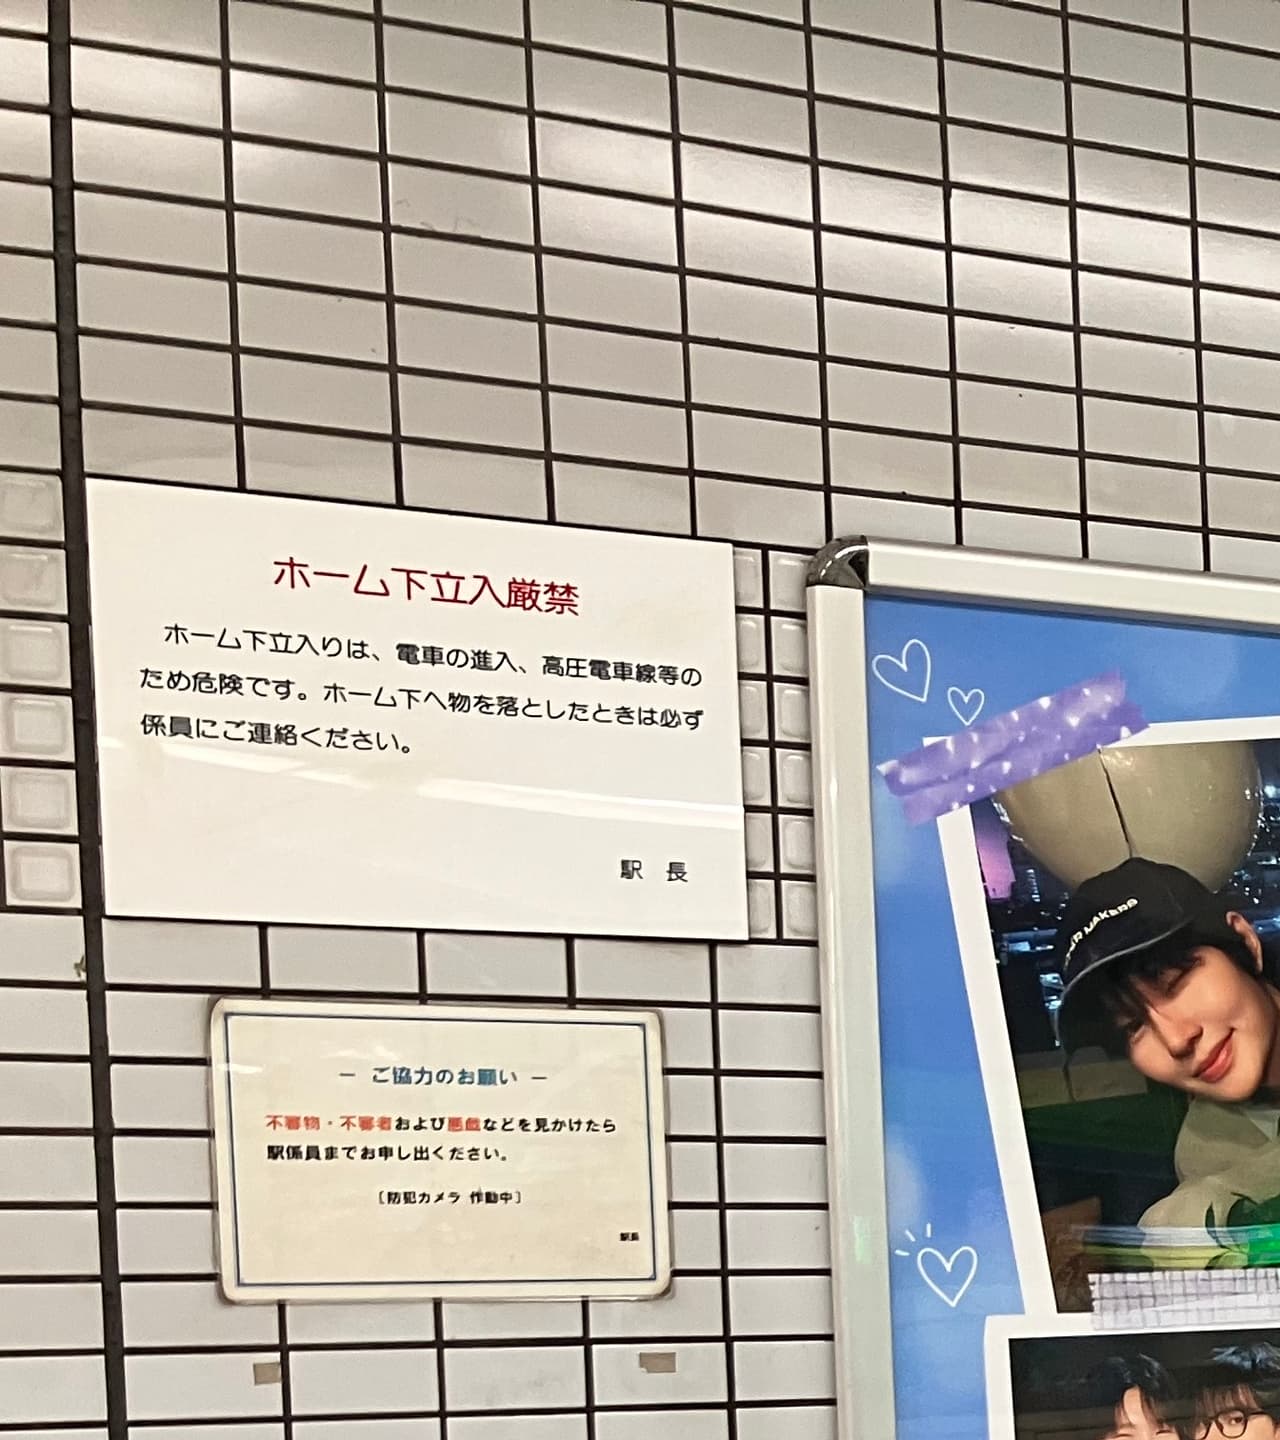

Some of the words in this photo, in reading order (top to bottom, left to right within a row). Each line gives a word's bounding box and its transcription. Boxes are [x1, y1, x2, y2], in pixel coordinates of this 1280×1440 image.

[273, 556, 580, 617] ホーム下立入厳禁
[163, 623, 702, 688] ホーム下立入りは、電車の進入、高圧電車線等の
[139, 667, 703, 731] ため危険です。ホーム下へ物を落としたときは必ず
[140, 713, 411, 754] 係員にご連絡ください。
[620, 859, 643, 881] 駅
[666, 861, 688, 884] 長
[372, 1066, 517, 1087] ご協力のお願い
[266, 1145, 508, 1162] 駅係員までお申し出ください。
